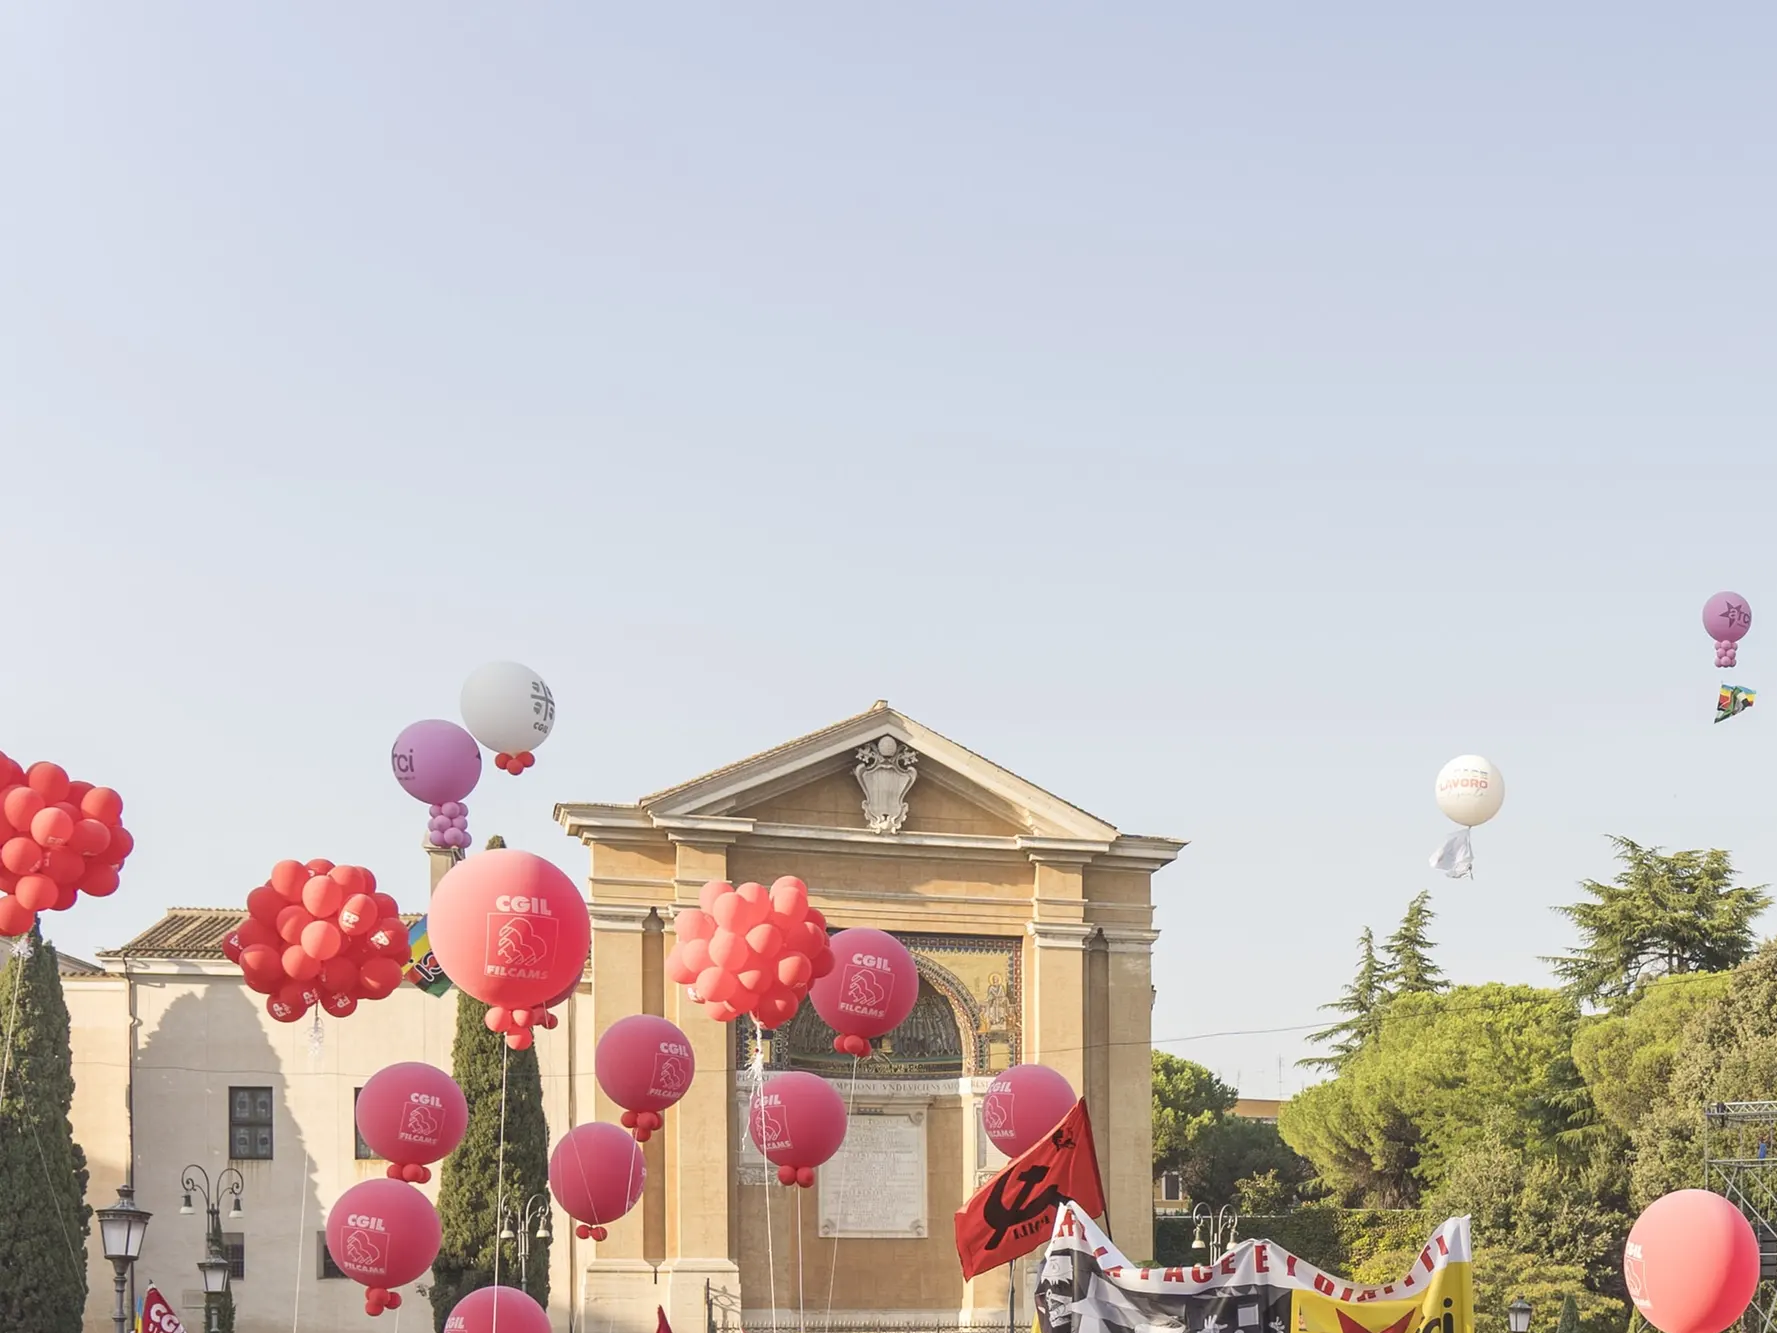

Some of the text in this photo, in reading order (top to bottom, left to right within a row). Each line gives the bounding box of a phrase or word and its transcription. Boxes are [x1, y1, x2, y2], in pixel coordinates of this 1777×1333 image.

[495, 894, 552, 916] CGIL
[851, 952, 891, 972] CGIL
[486, 963, 550, 981] FILCAMS
[839, 1001, 886, 1019] FILCAMS
[659, 1042, 690, 1058] CGIL
[410, 1092, 442, 1108] CGIL
[754, 1094, 781, 1110] CGIL
[399, 1131, 439, 1146] FILCAMS
[347, 1213, 386, 1232] CGIL
[343, 1261, 386, 1275] FILCAMS
